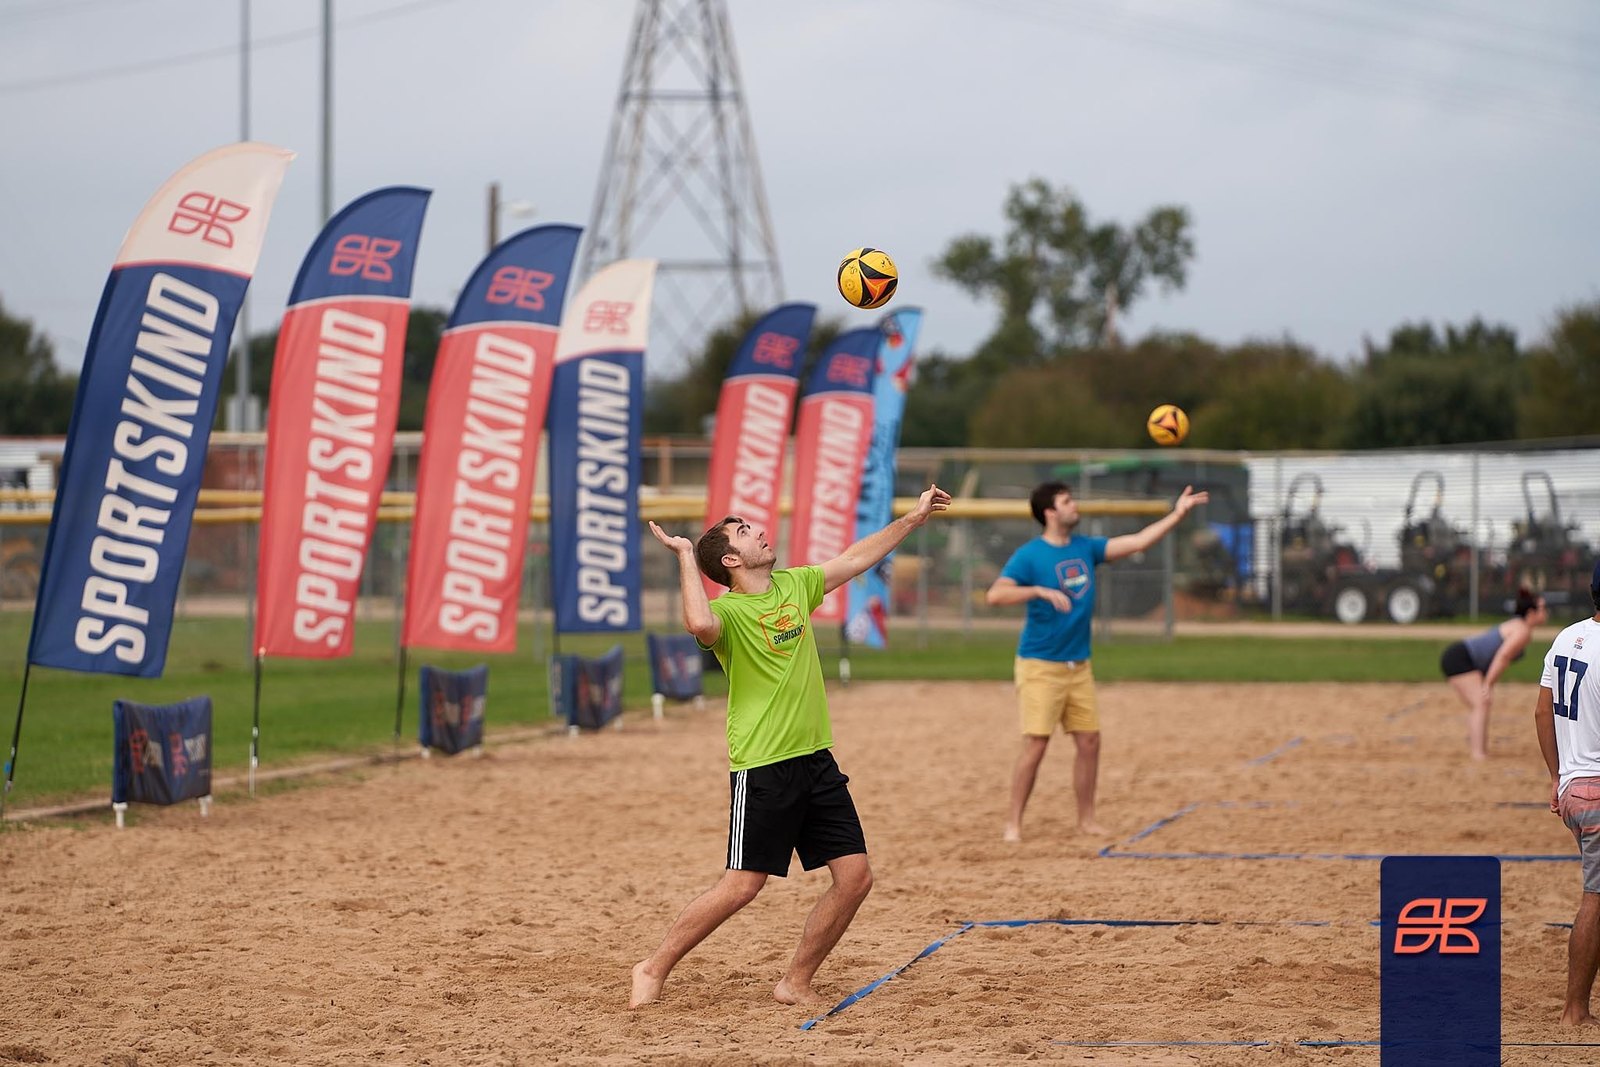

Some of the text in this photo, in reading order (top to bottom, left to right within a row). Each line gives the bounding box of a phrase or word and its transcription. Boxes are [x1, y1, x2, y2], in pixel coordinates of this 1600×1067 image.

[75, 272, 220, 665] SPORTSKIND
[293, 308, 387, 647] SPORTSKIND
[438, 332, 536, 642] SPORTSKIND
[578, 358, 631, 626] SPORTSKIND
[728, 382, 790, 530] TSKIND
[1553, 654, 1588, 721] 17
